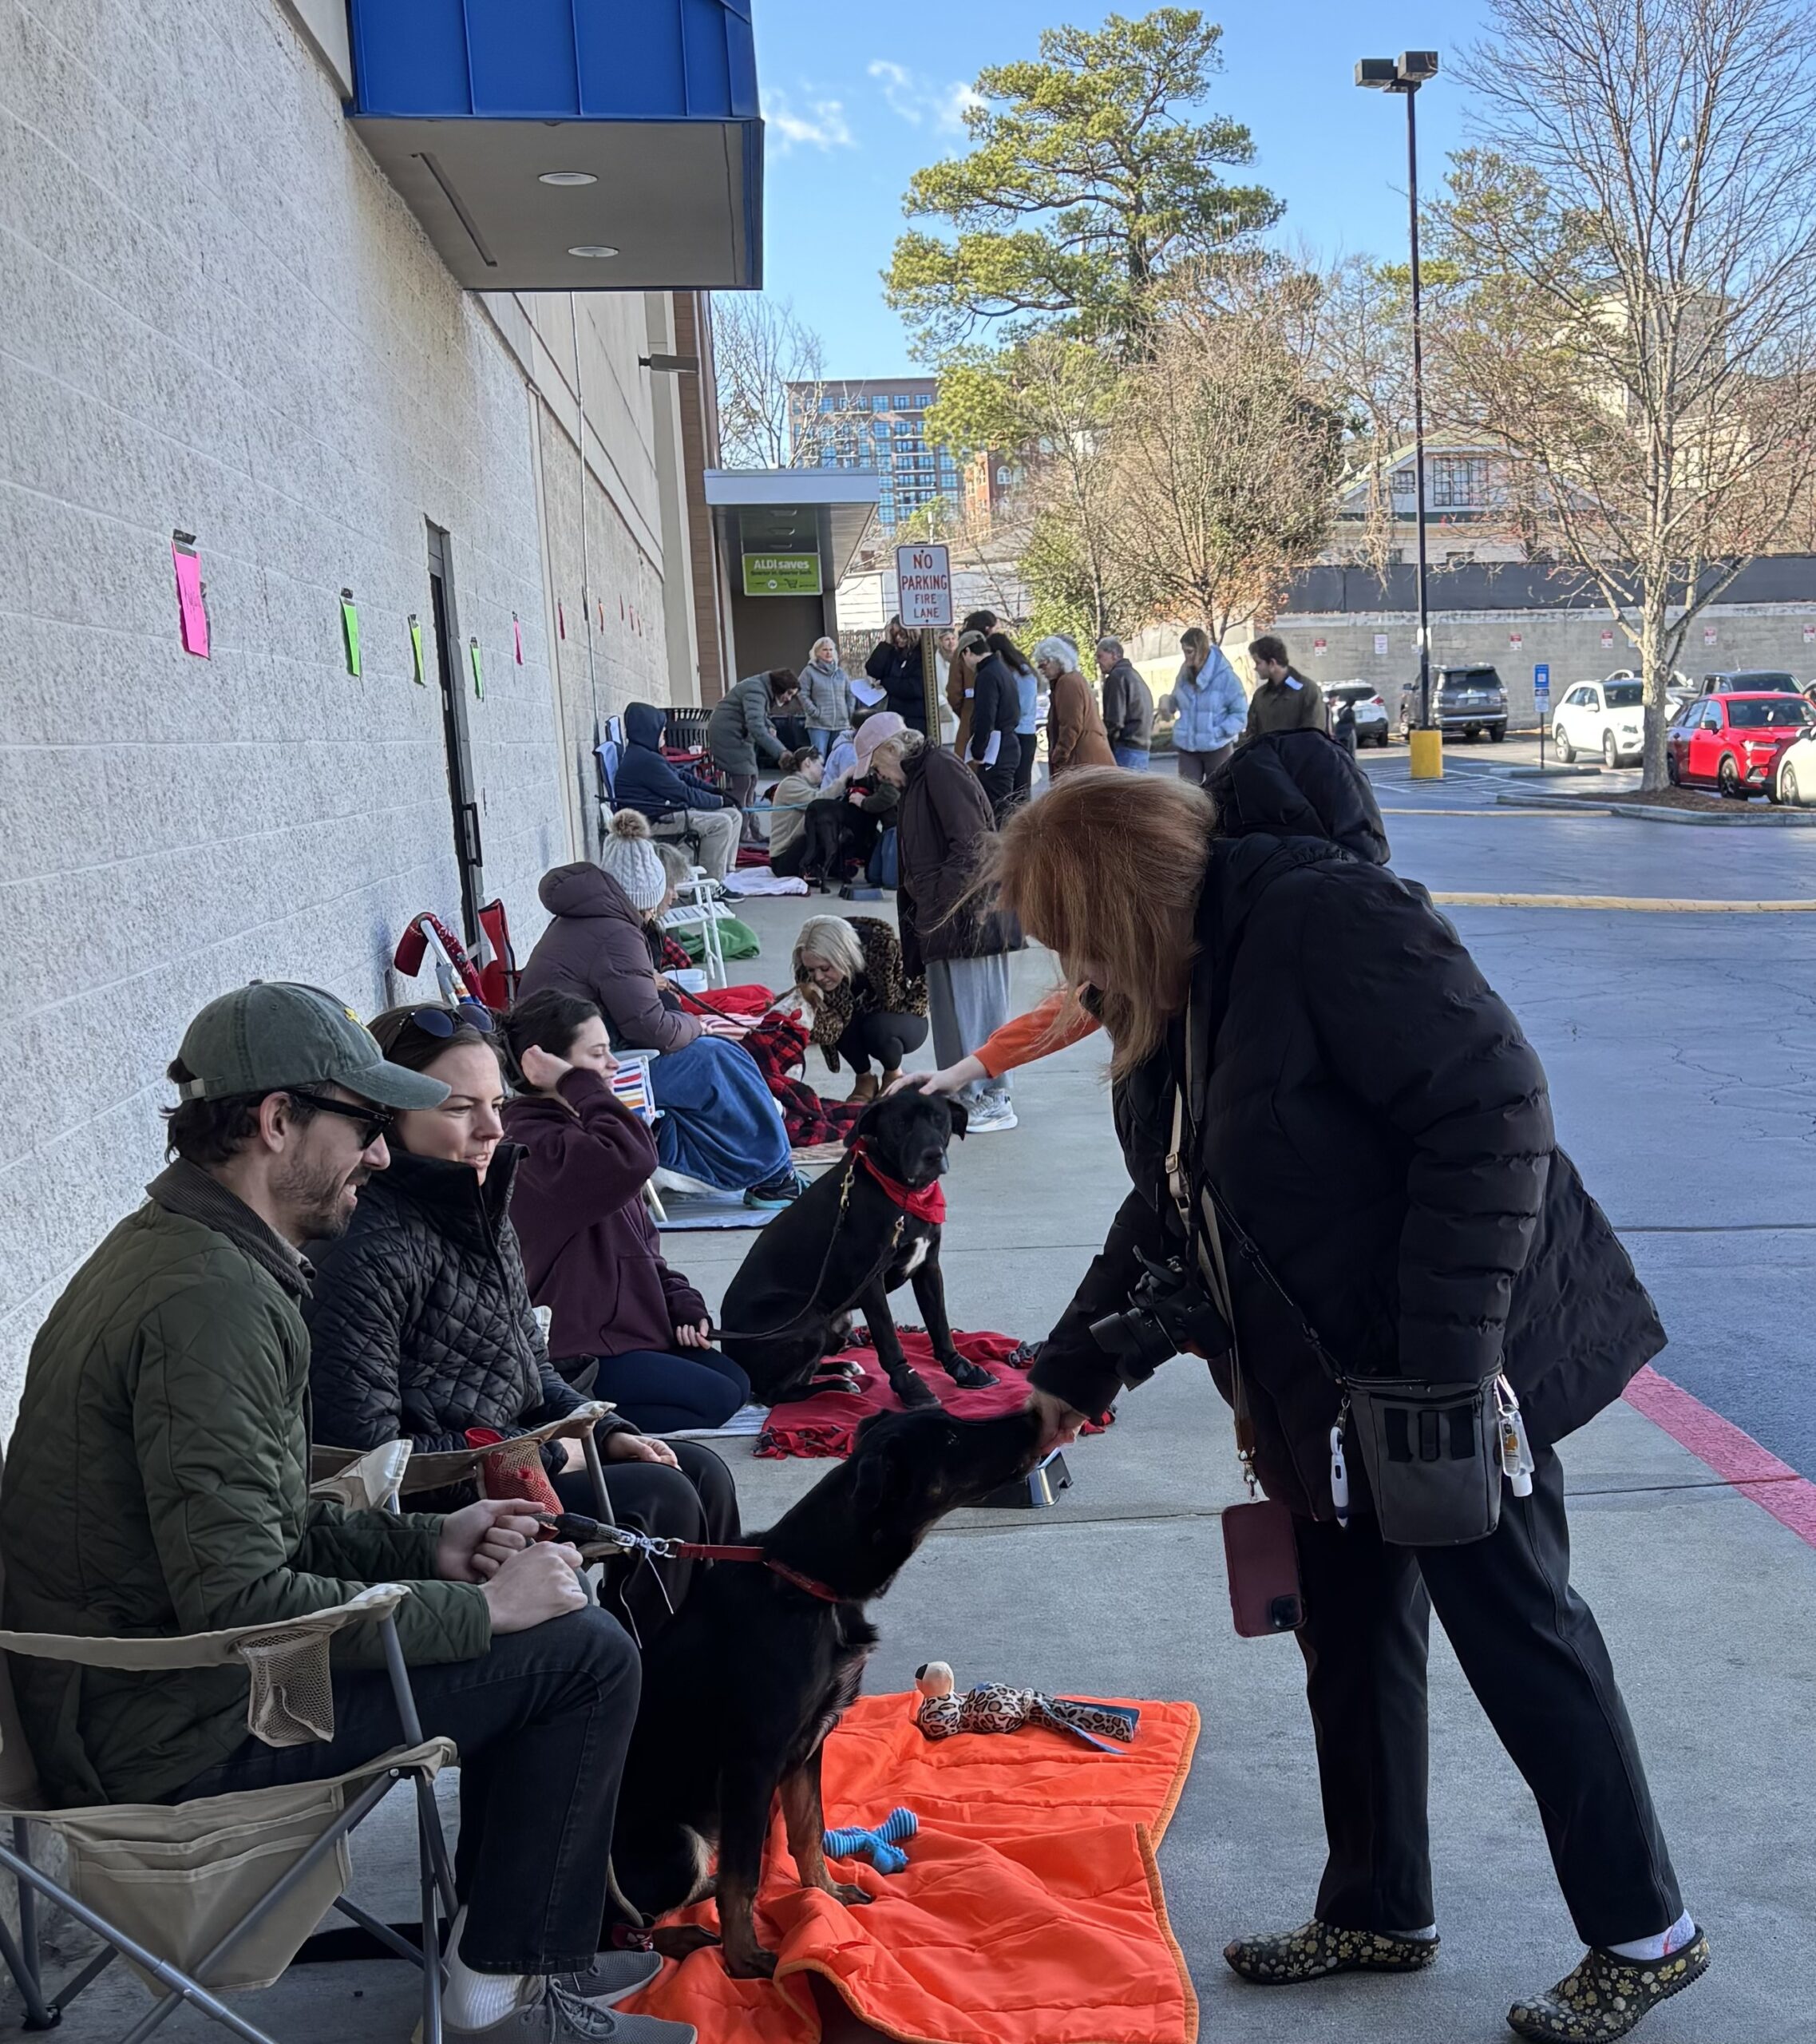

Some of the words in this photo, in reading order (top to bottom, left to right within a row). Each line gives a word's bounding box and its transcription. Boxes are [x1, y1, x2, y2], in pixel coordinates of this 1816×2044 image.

[754, 559, 777, 569] ALDI
[778, 560, 809, 569] saves
[913, 554, 932, 569] NO
[901, 574, 948, 591] PARKING
[915, 593, 937, 604] FIRE
[914, 608, 940, 618] LANE
